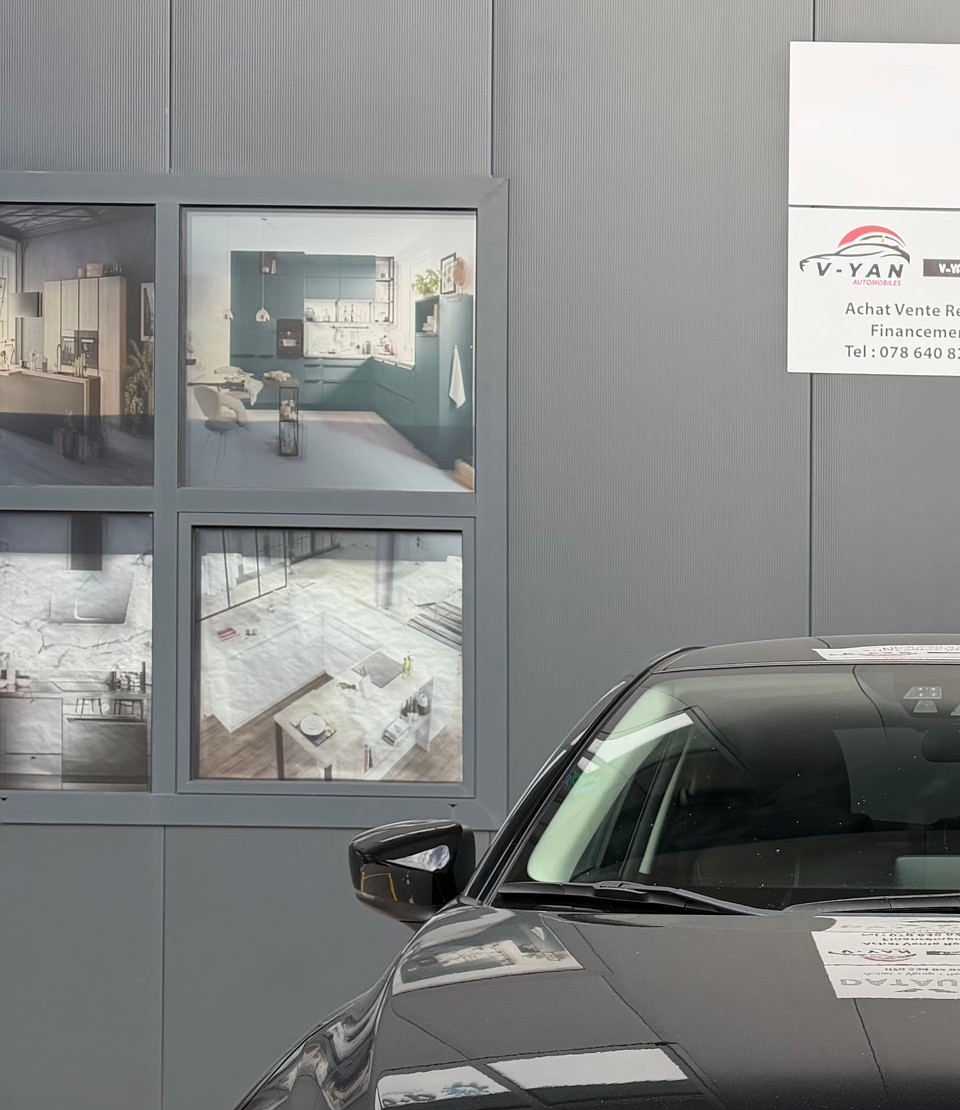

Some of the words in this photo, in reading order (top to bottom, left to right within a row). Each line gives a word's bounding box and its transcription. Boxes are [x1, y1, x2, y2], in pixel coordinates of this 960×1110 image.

[816, 262, 904, 279] V-YAN
[852, 279, 902, 287] AUTOMOBILES
[845, 302, 891, 316] Achat
[894, 303, 941, 317] Vente
[879, 346, 909, 359] 078
[913, 347, 943, 360] 640
